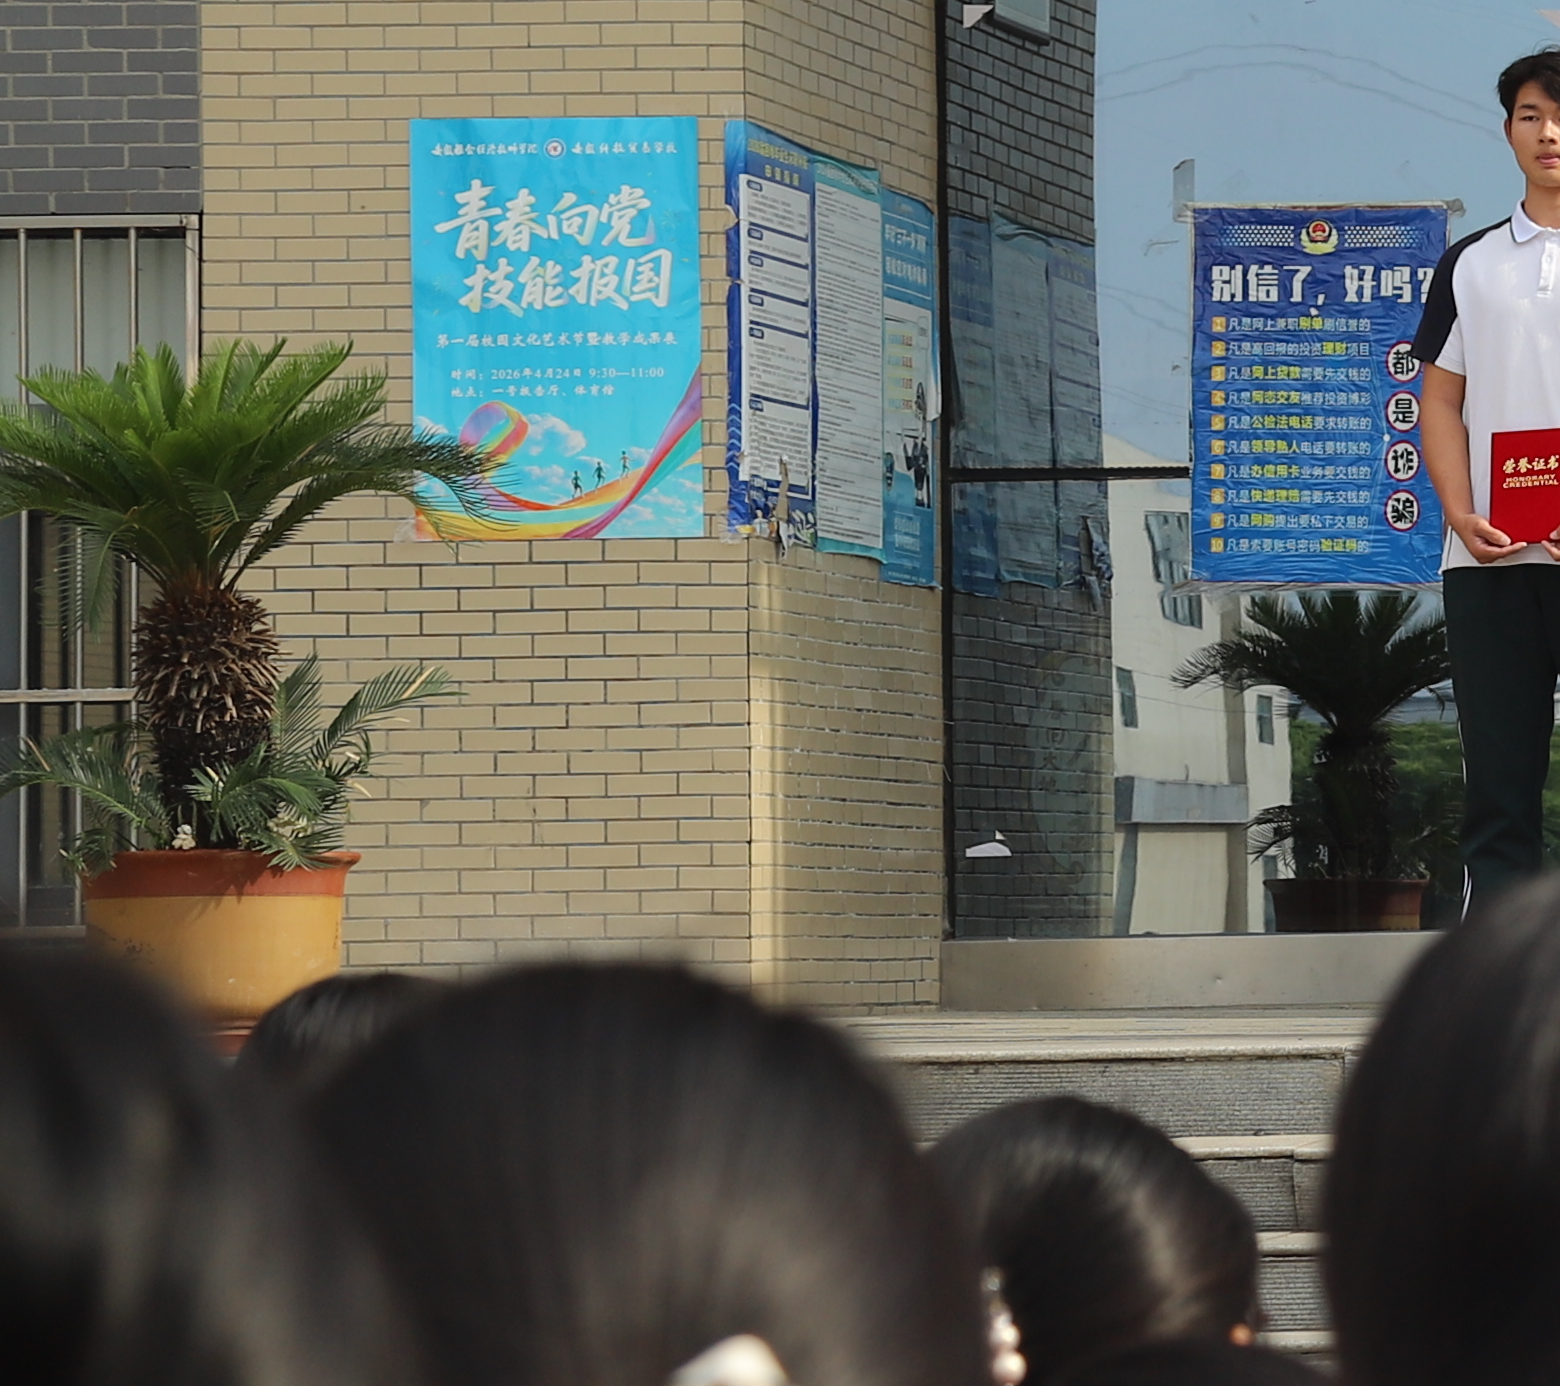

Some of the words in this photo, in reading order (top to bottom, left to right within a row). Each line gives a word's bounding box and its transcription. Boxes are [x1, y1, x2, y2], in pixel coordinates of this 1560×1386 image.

[434, 178, 656, 261] 青春向党
[458, 247, 673, 317] 技能报国
[1503, 454, 1560, 474] 荣誉证书
[1502, 478, 1559, 489] CREDENTIAL
[1505, 473, 1557, 485] HONORARY
